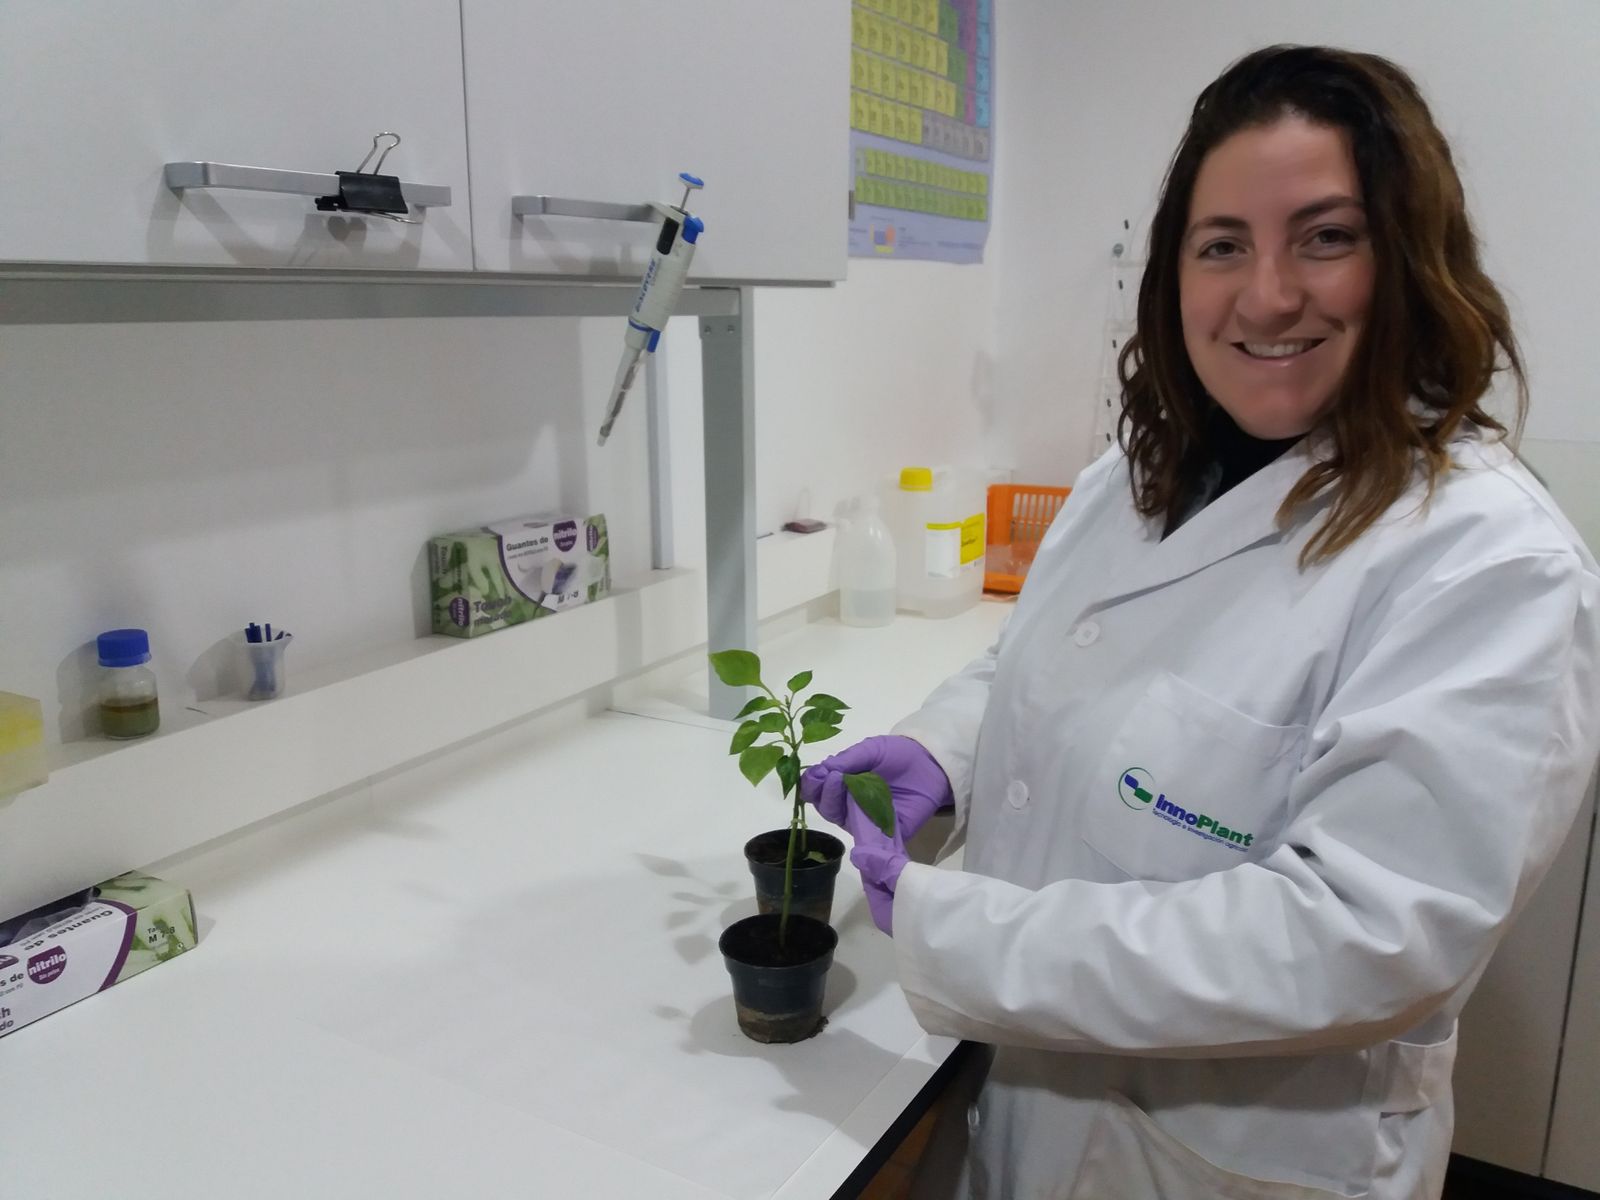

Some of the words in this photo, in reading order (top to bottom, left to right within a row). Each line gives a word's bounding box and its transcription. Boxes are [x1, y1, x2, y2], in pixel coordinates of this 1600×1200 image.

[506, 538, 539, 552] Guantes
[1156, 794, 1254, 847] InnoPlant
[48, 910, 114, 938] Guantes
[24, 938, 45, 951] de
[28, 952, 67, 976] nitrilo
[10, 971, 24, 983] de
